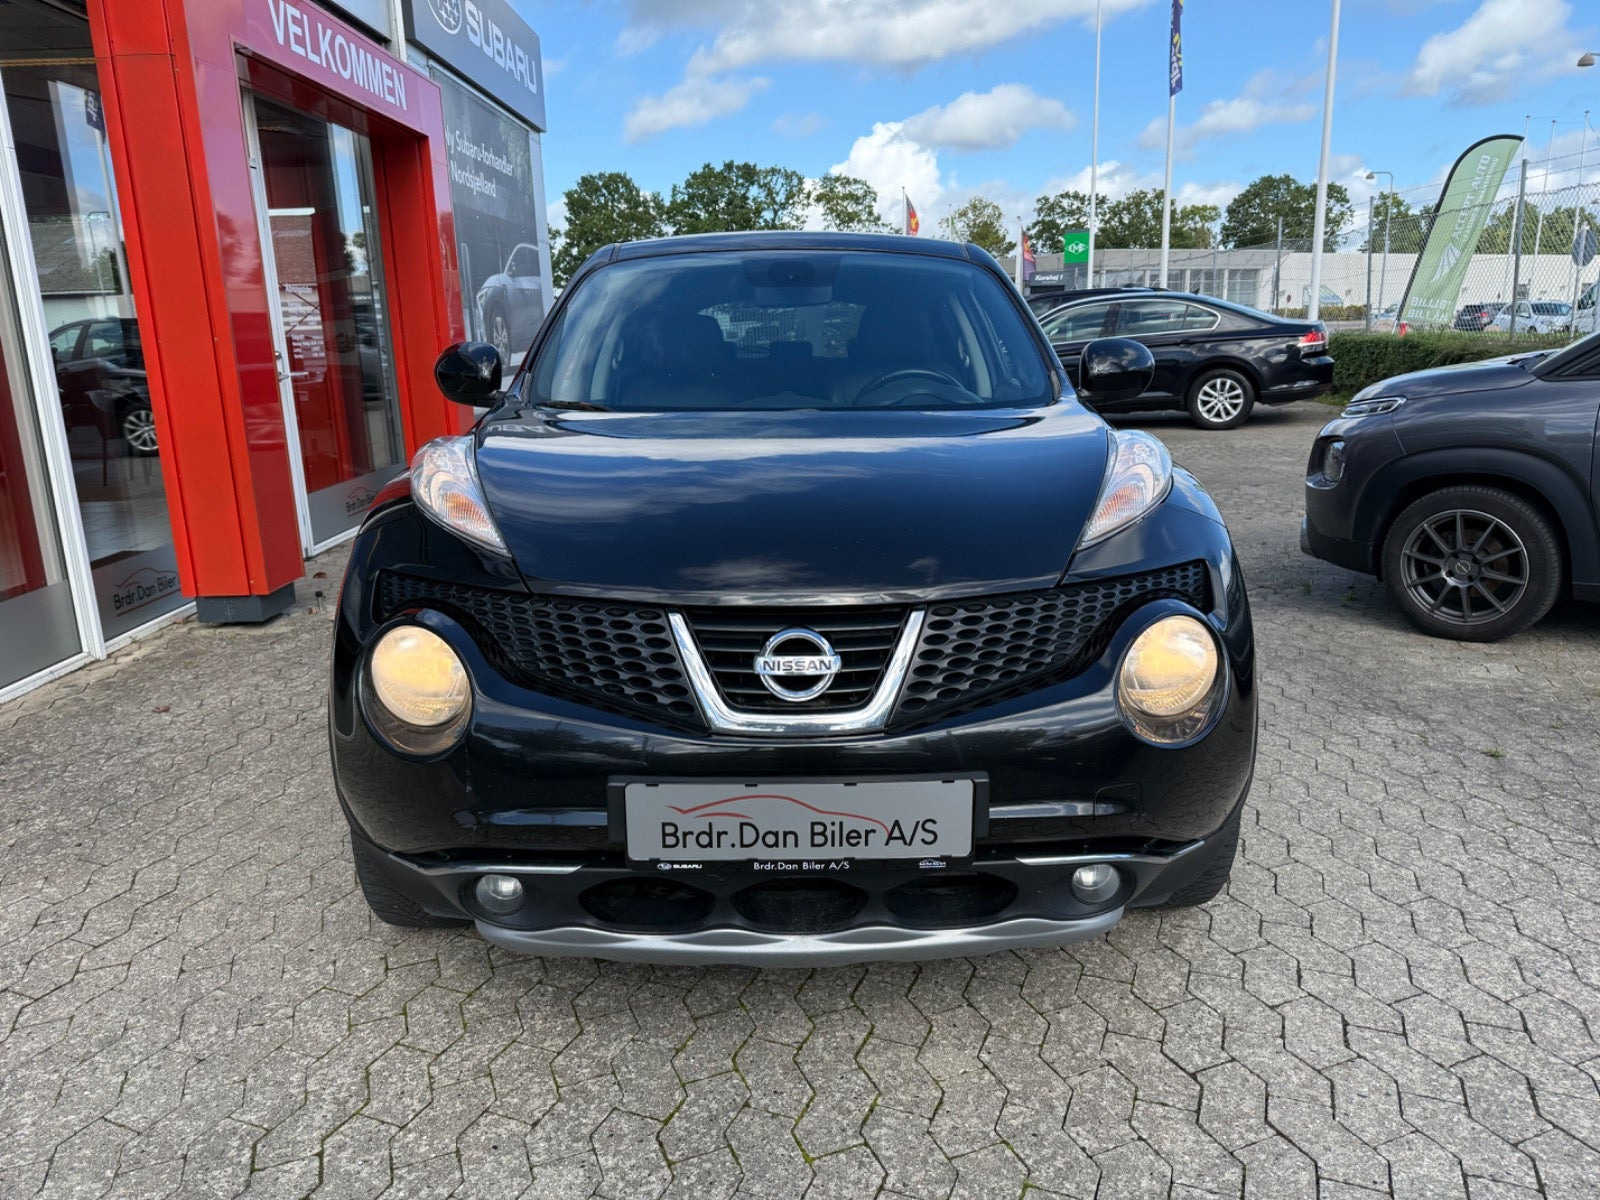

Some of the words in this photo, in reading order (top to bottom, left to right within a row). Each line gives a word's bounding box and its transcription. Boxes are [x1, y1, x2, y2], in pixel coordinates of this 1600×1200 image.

[268, 0, 407, 111] VELKOMMEN
[465, 0, 537, 94] SUBARU
[157, 576, 177, 592] Biler
[763, 660, 832, 672] NISSAN
[661, 820, 799, 850] Brdr.Dan
[810, 819, 877, 848] Biler
[885, 817, 939, 848] A/S
[753, 861, 799, 871] Brdr.Dan
[802, 861, 825, 870] Biler
[829, 860, 850, 870] A/S
